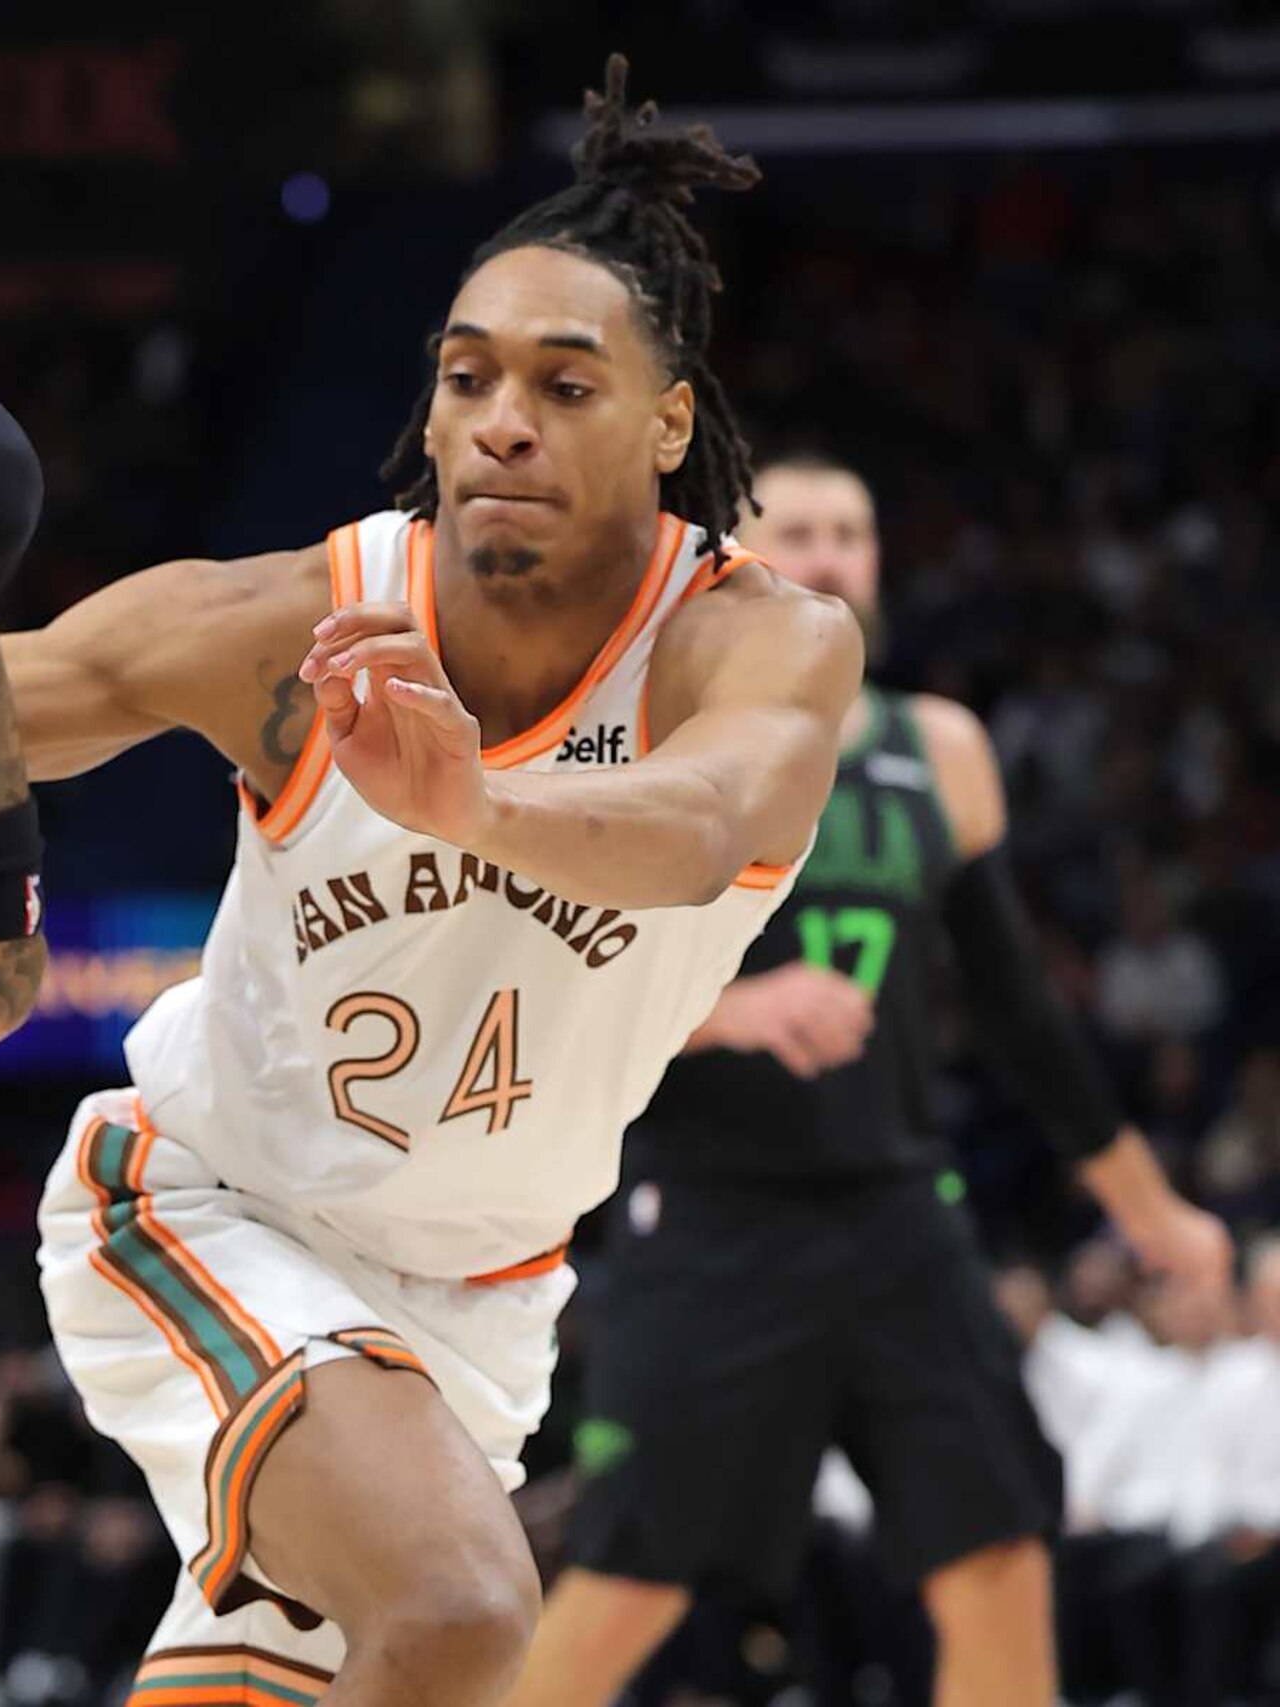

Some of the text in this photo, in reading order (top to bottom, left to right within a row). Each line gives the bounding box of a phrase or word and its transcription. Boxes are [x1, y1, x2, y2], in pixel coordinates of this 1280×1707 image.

[556, 724, 629, 764] Self.
[405, 852, 638, 969] ANONIO
[796, 906, 896, 998] 17
[324, 987, 532, 1153] 24
